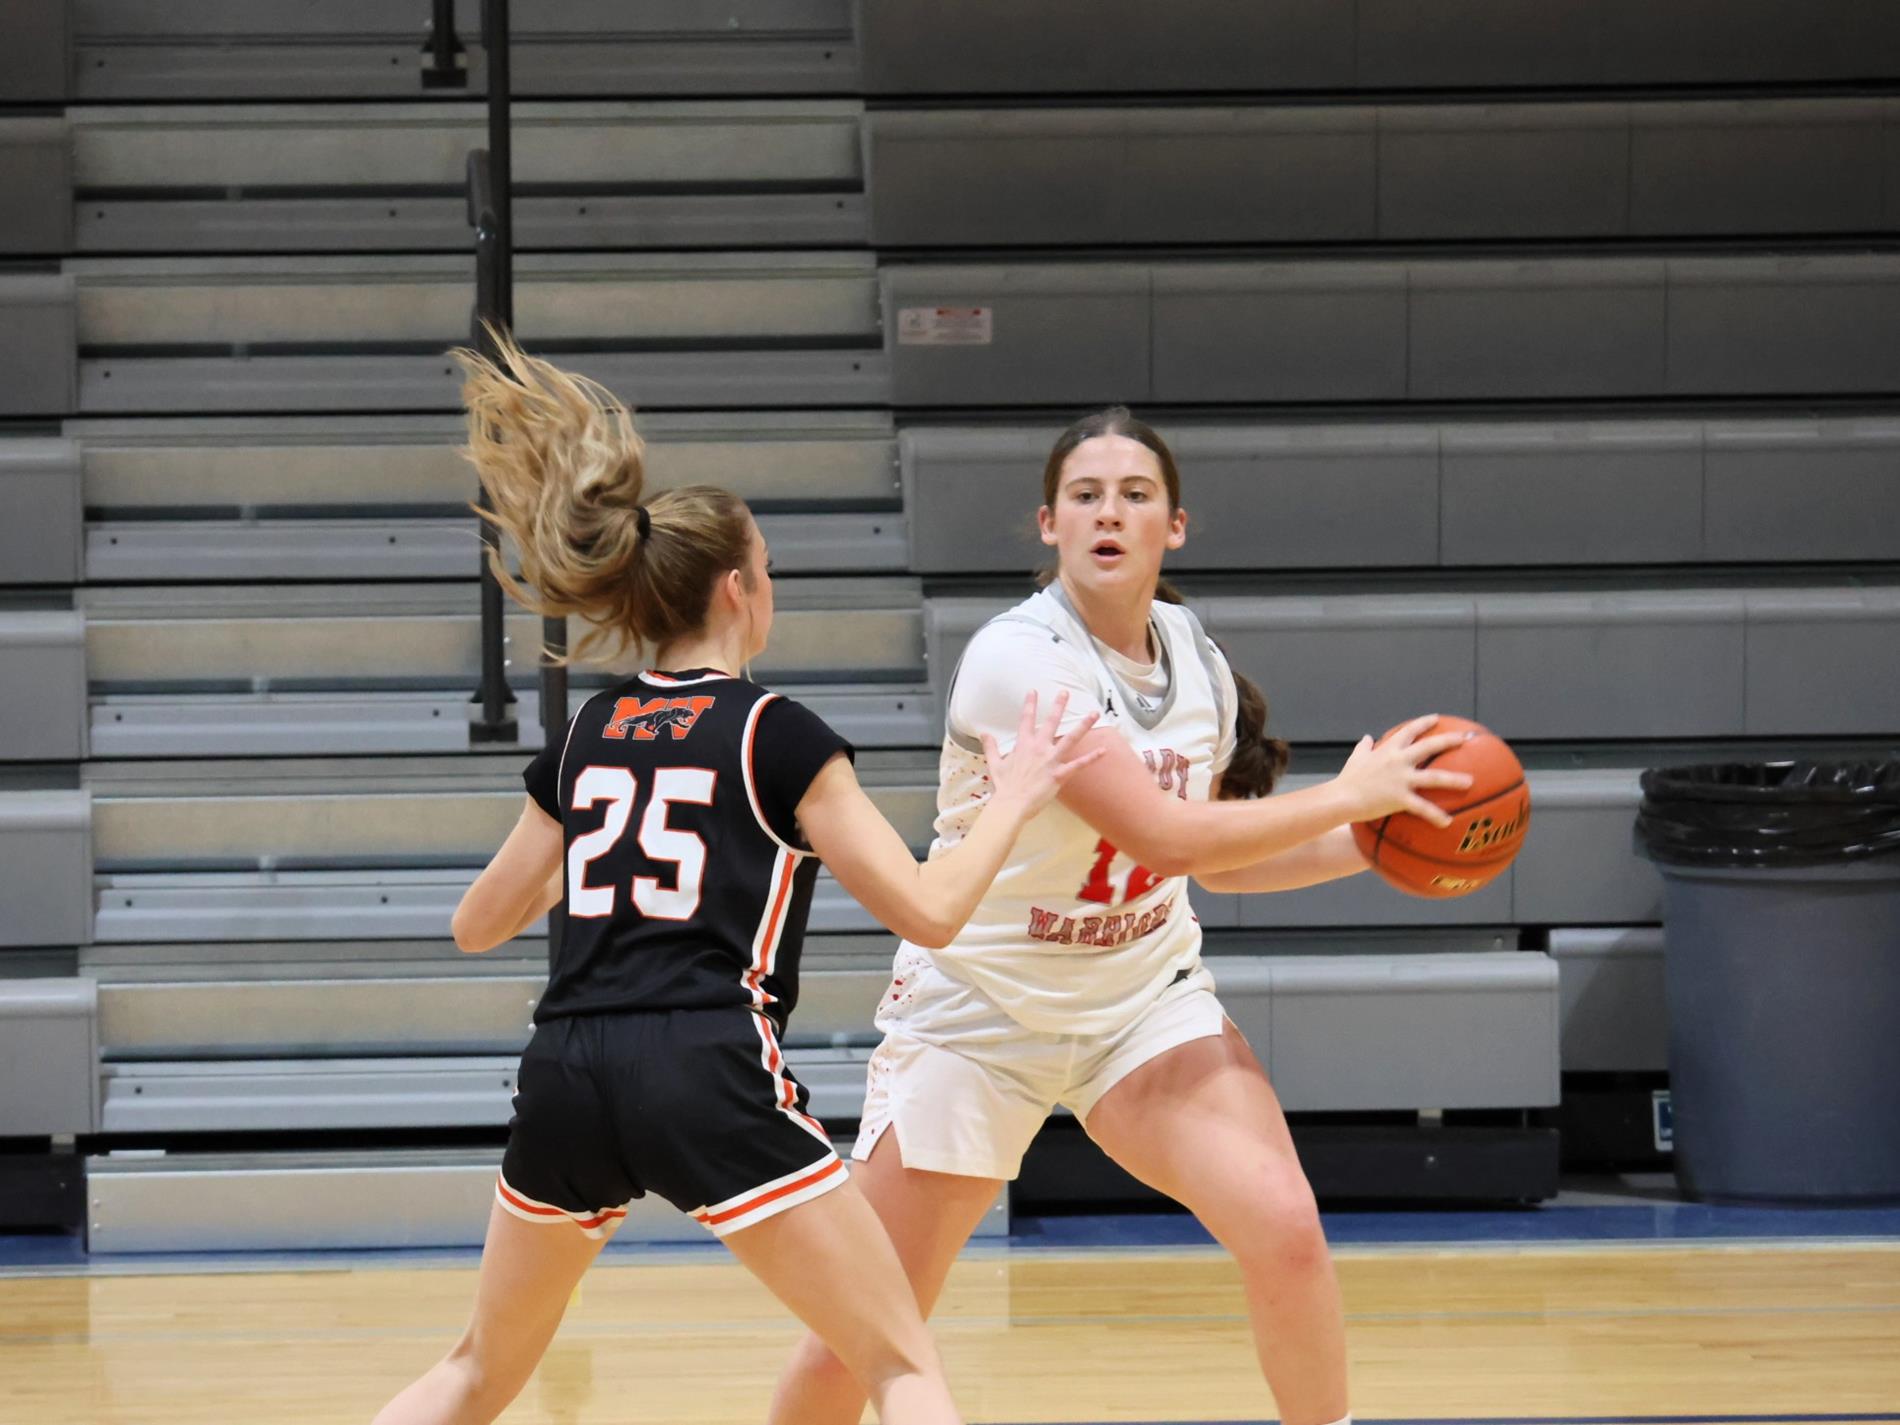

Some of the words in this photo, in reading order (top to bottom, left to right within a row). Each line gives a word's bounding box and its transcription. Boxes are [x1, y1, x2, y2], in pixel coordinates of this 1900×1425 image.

[602, 696, 716, 740] MV
[568, 765, 718, 920] 25
[1028, 896, 1174, 947] WARRIOR
